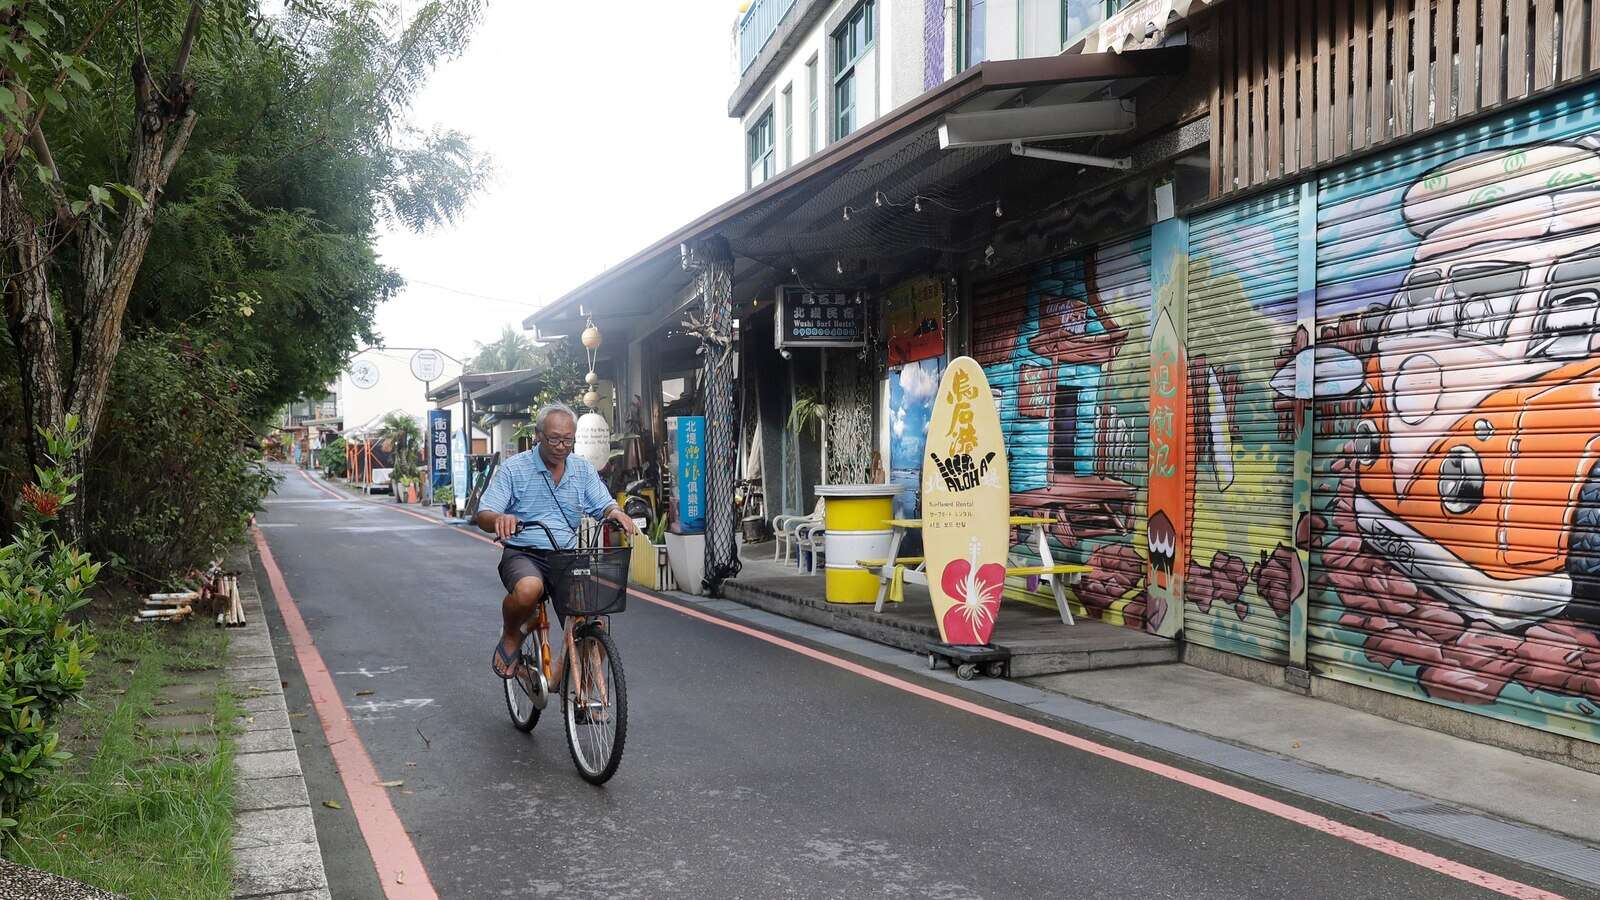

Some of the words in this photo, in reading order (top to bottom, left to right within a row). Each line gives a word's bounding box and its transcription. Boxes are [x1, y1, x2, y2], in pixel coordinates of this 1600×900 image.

[945, 367, 979, 458] 烏石港
[434, 417, 448, 470] 衝浪國度
[944, 458, 989, 492] ALOHA
[955, 500, 973, 508] Rental
